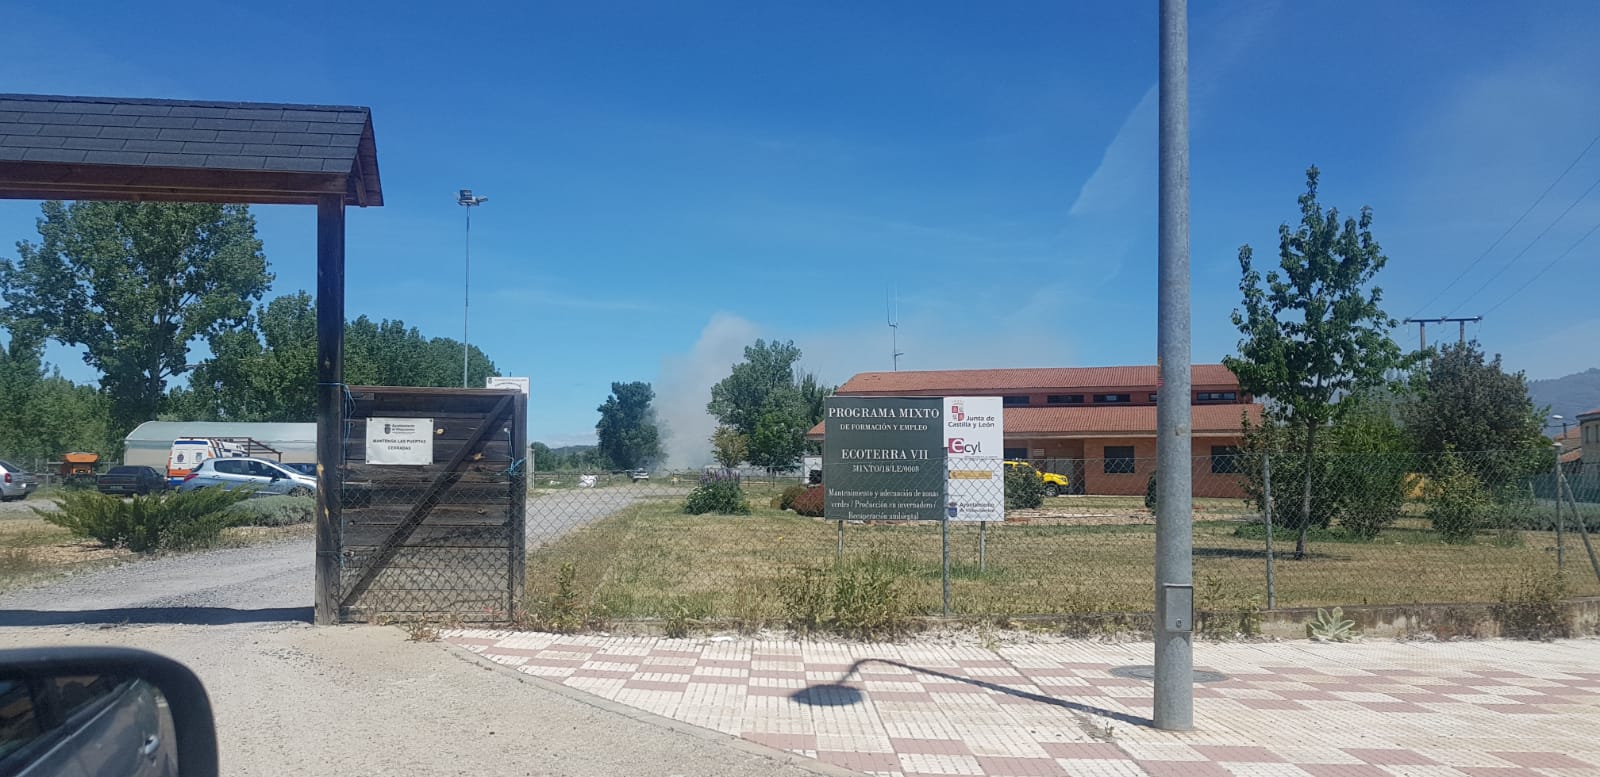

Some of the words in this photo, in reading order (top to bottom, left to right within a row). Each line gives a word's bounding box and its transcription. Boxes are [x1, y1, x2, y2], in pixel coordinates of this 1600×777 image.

[828, 407, 896, 418] PROGRAMA
[899, 408, 939, 418] MIXTO
[851, 423, 891, 431] FORMACIÓN
[841, 449, 906, 460] ECOTERRA
[910, 449, 928, 460] VII
[828, 489, 873, 497] Mantenimiento
[879, 489, 912, 497] adecuación
[913, 489, 921, 497] de
[831, 500, 849, 508] verdes
[854, 499, 887, 508] Producción
[897, 501, 932, 509] invernadero
[848, 511, 887, 520] Recuperación
[888, 511, 919, 520] ambiental
